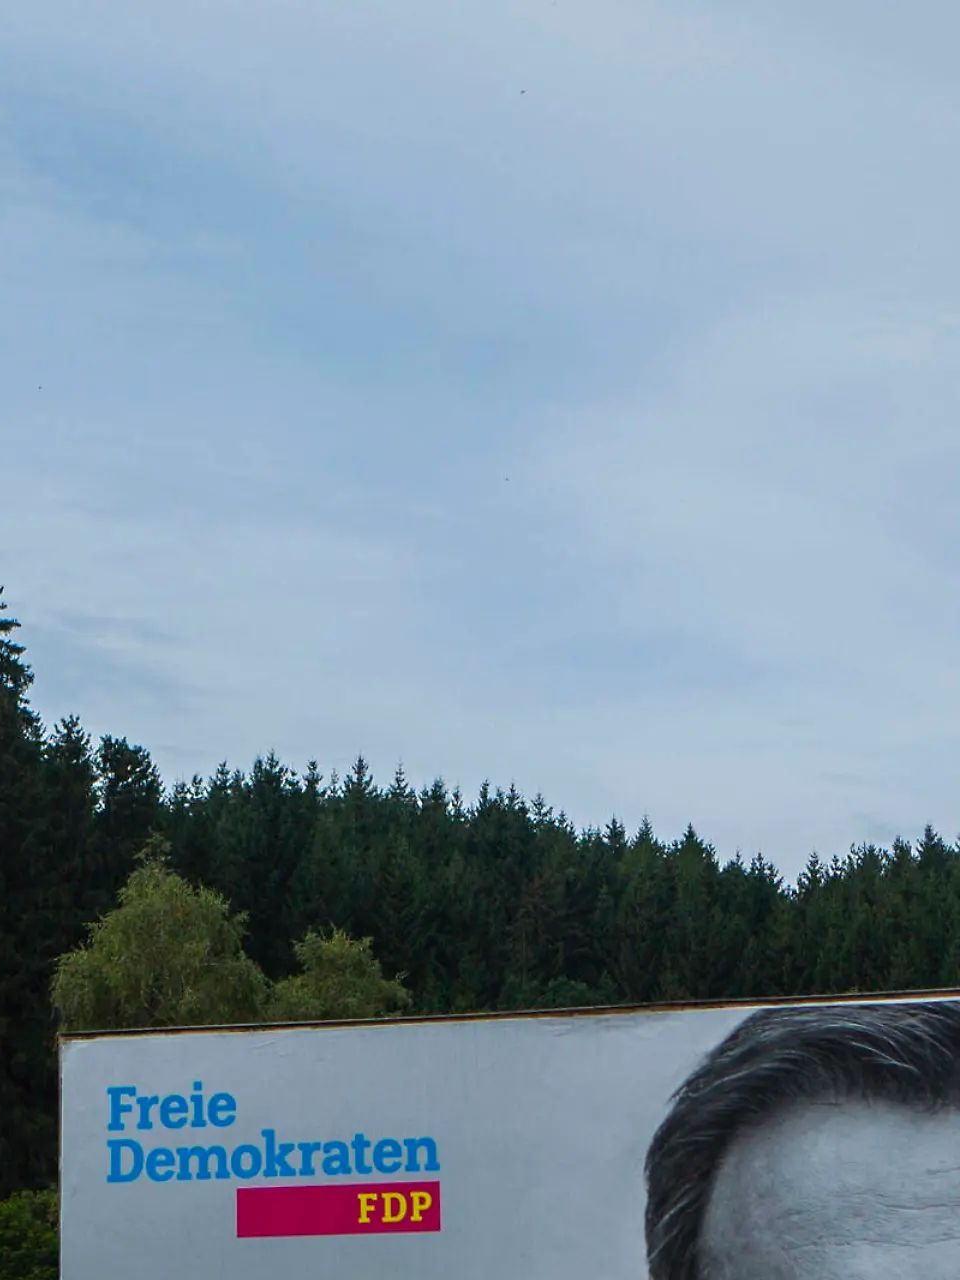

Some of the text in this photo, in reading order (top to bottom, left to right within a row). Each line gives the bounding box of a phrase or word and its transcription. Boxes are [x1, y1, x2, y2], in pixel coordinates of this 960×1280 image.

[105, 1081, 237, 1132] Freie
[105, 1130, 441, 1184] Demokraten
[357, 1191, 432, 1224] FDP
